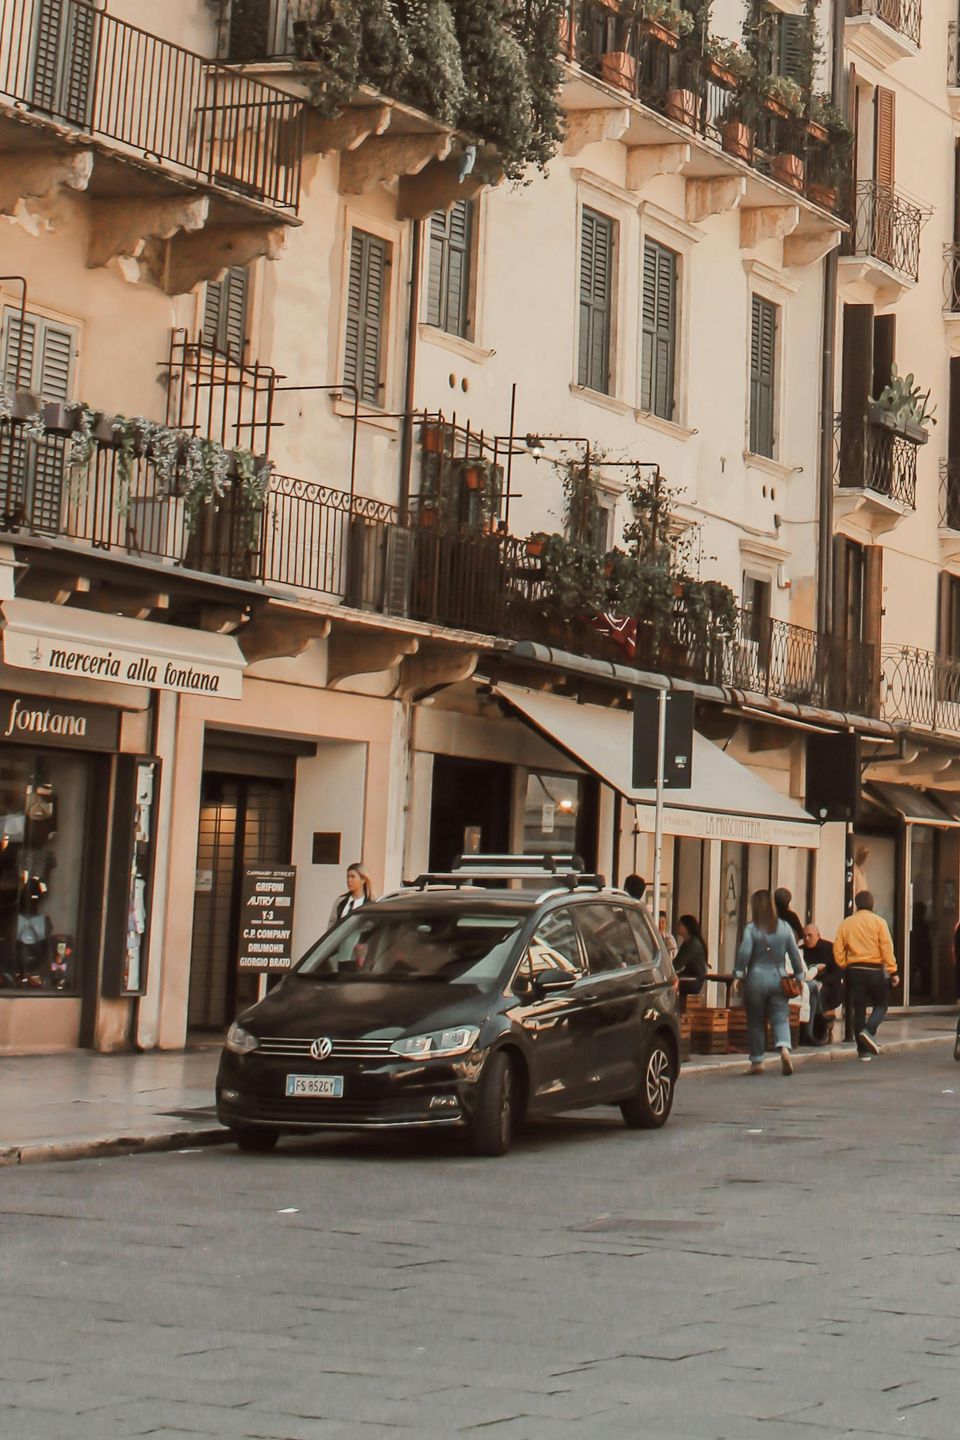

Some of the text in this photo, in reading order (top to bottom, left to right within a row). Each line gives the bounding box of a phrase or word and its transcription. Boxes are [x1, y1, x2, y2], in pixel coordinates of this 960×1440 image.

[49, 648, 220, 692] merceria alla fontana
[5, 698, 88, 737] fontana
[255, 882, 284, 893] GRIFONI
[246, 895, 275, 906] AUTRY
[262, 910, 274, 920] Y-3
[257, 929, 291, 939] COMPANY
[248, 943, 284, 953] DRUMOHR
[240, 956, 291, 967] GIORGIO BRATO
